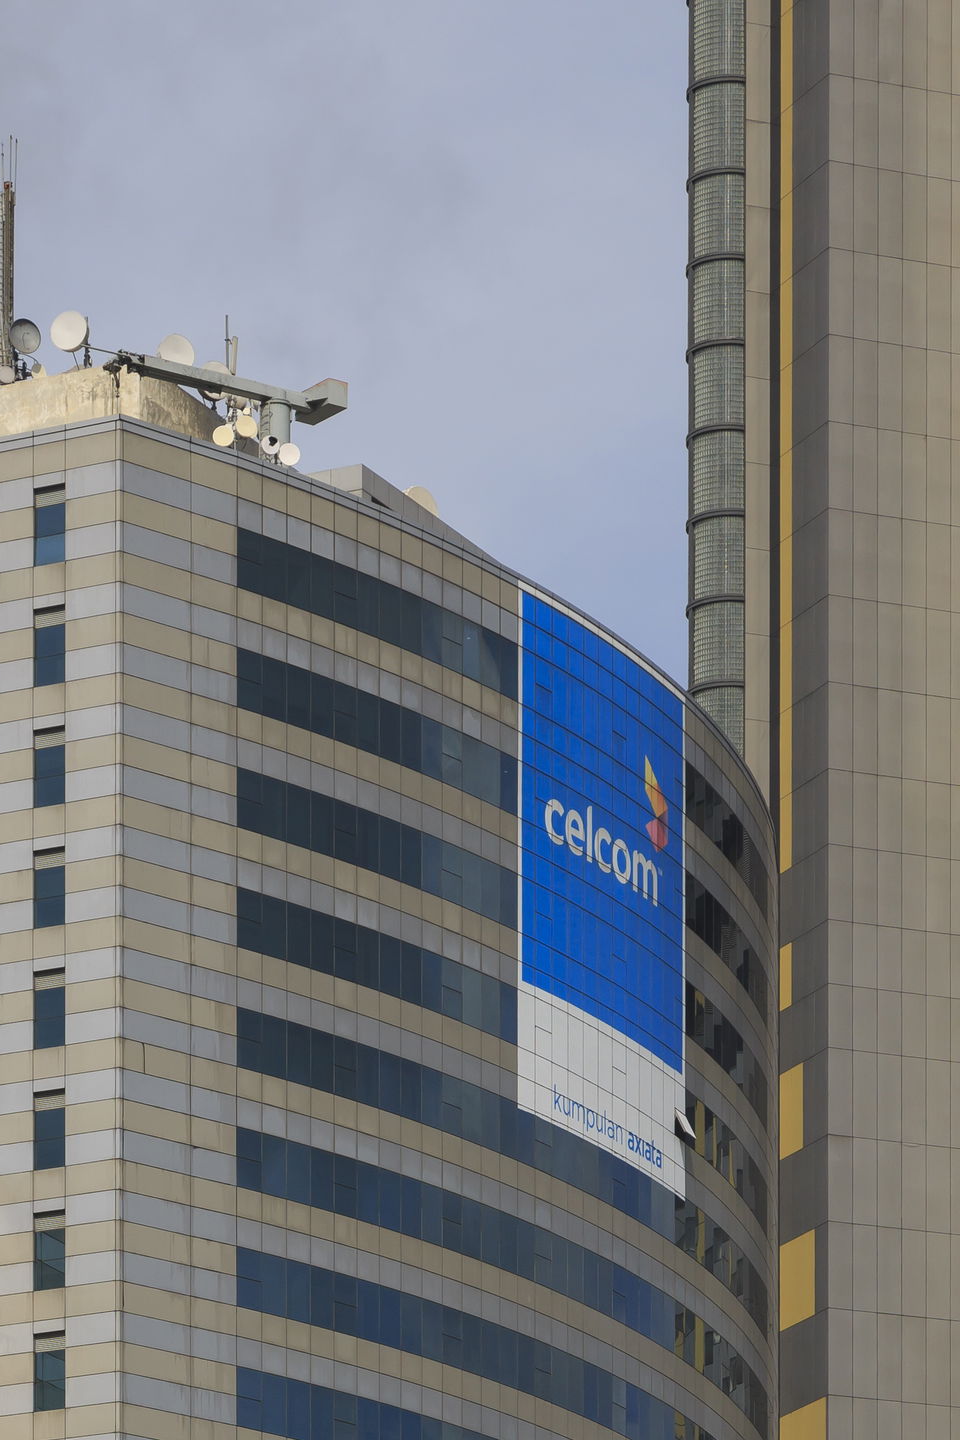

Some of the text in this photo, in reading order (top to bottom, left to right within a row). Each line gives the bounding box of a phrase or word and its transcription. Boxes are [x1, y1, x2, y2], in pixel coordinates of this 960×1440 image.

[545, 799, 658, 907] celcom
[553, 1084, 662, 1169] kumpulan axiata
